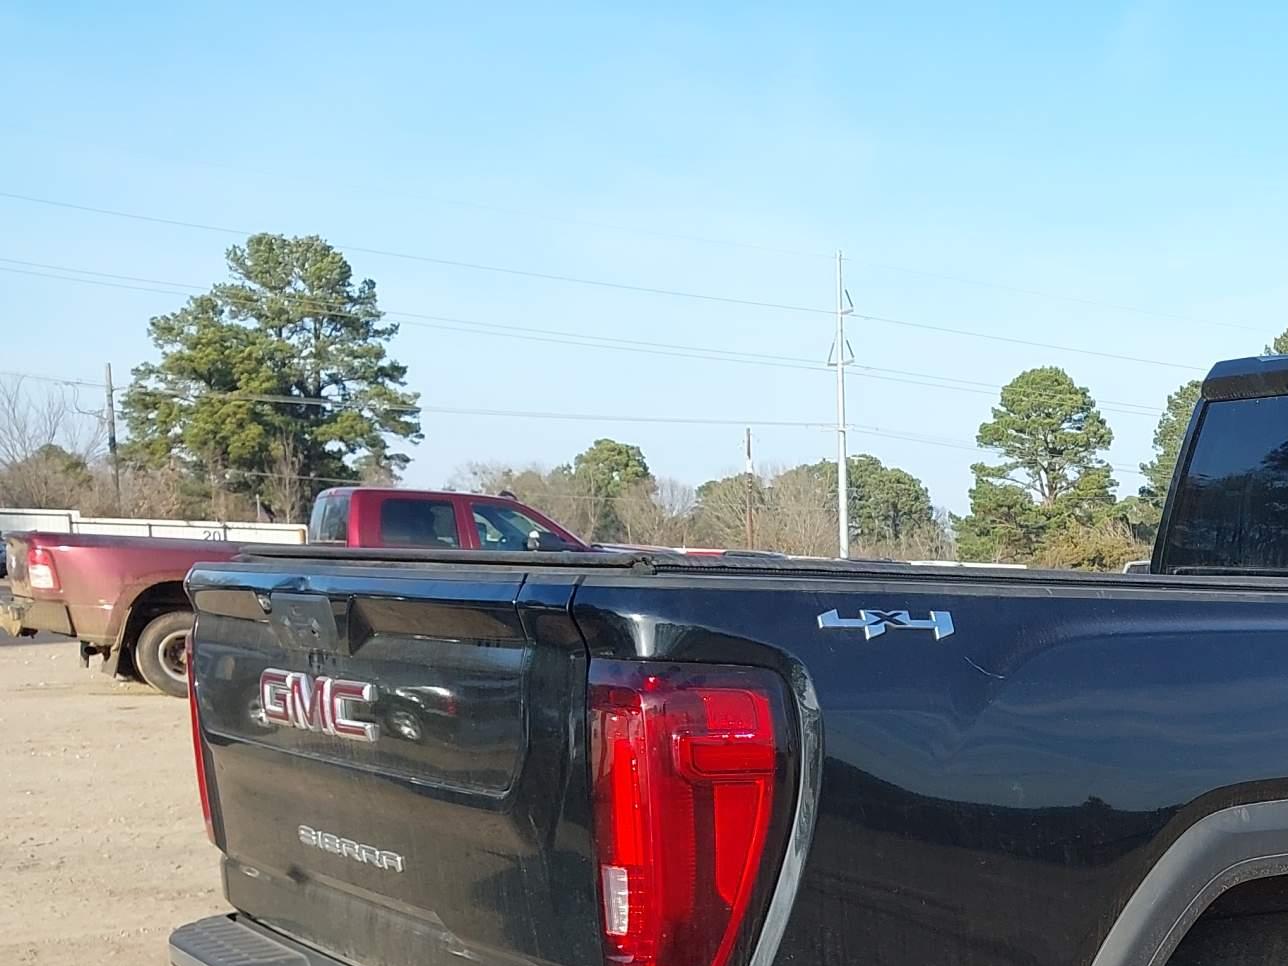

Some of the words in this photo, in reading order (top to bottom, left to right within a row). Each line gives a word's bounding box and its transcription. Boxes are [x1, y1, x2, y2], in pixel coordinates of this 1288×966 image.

[203, 530, 221, 541] 20
[260, 667, 379, 743] GMC
[298, 824, 405, 873] SIERRA
